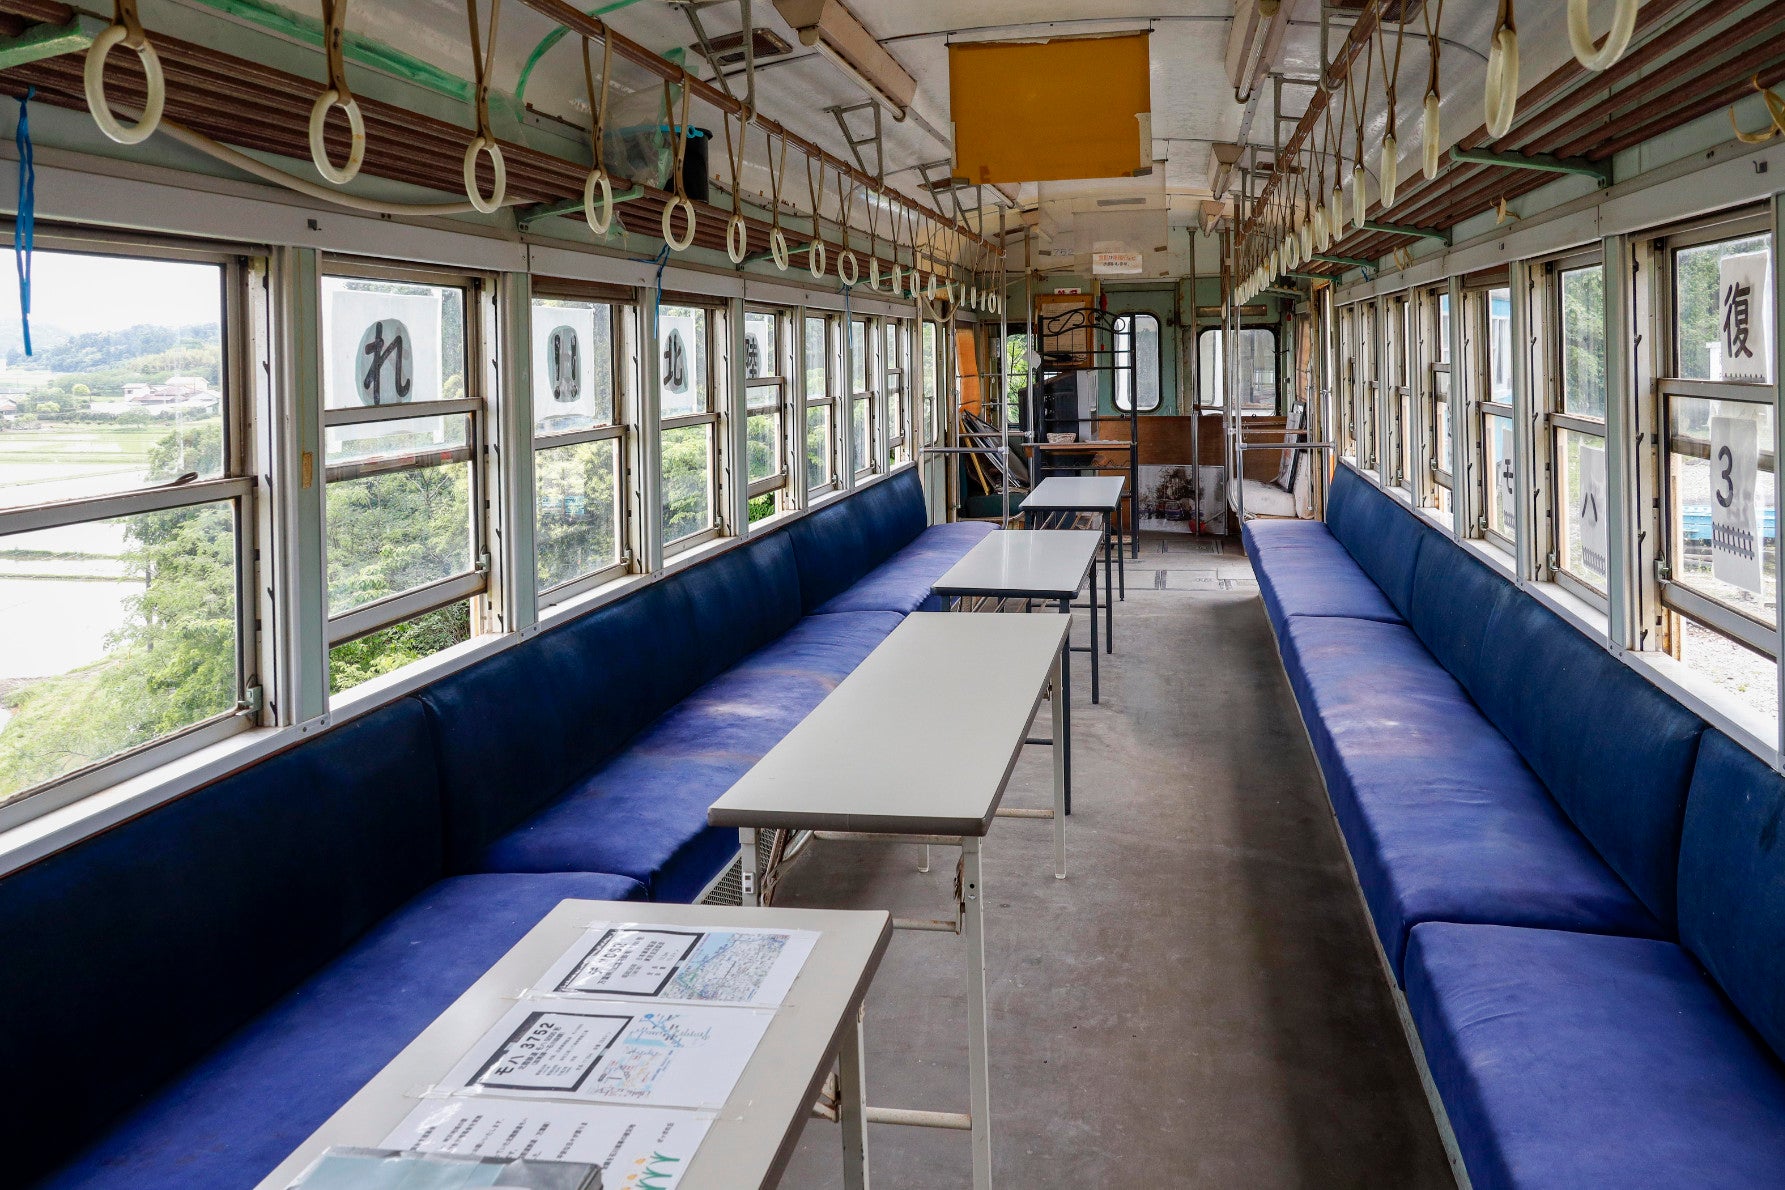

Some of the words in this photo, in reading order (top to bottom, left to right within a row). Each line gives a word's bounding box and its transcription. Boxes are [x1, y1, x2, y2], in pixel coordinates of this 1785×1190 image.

[1723, 282, 1753, 358] 復
[363, 321, 411, 405] れ
[663, 334, 683, 386] 北
[1716, 446, 1734, 507] 3
[1582, 492, 1598, 522] ハ
[494, 1054, 524, 1075] モハ
[519, 1022, 555, 1049] 3752
